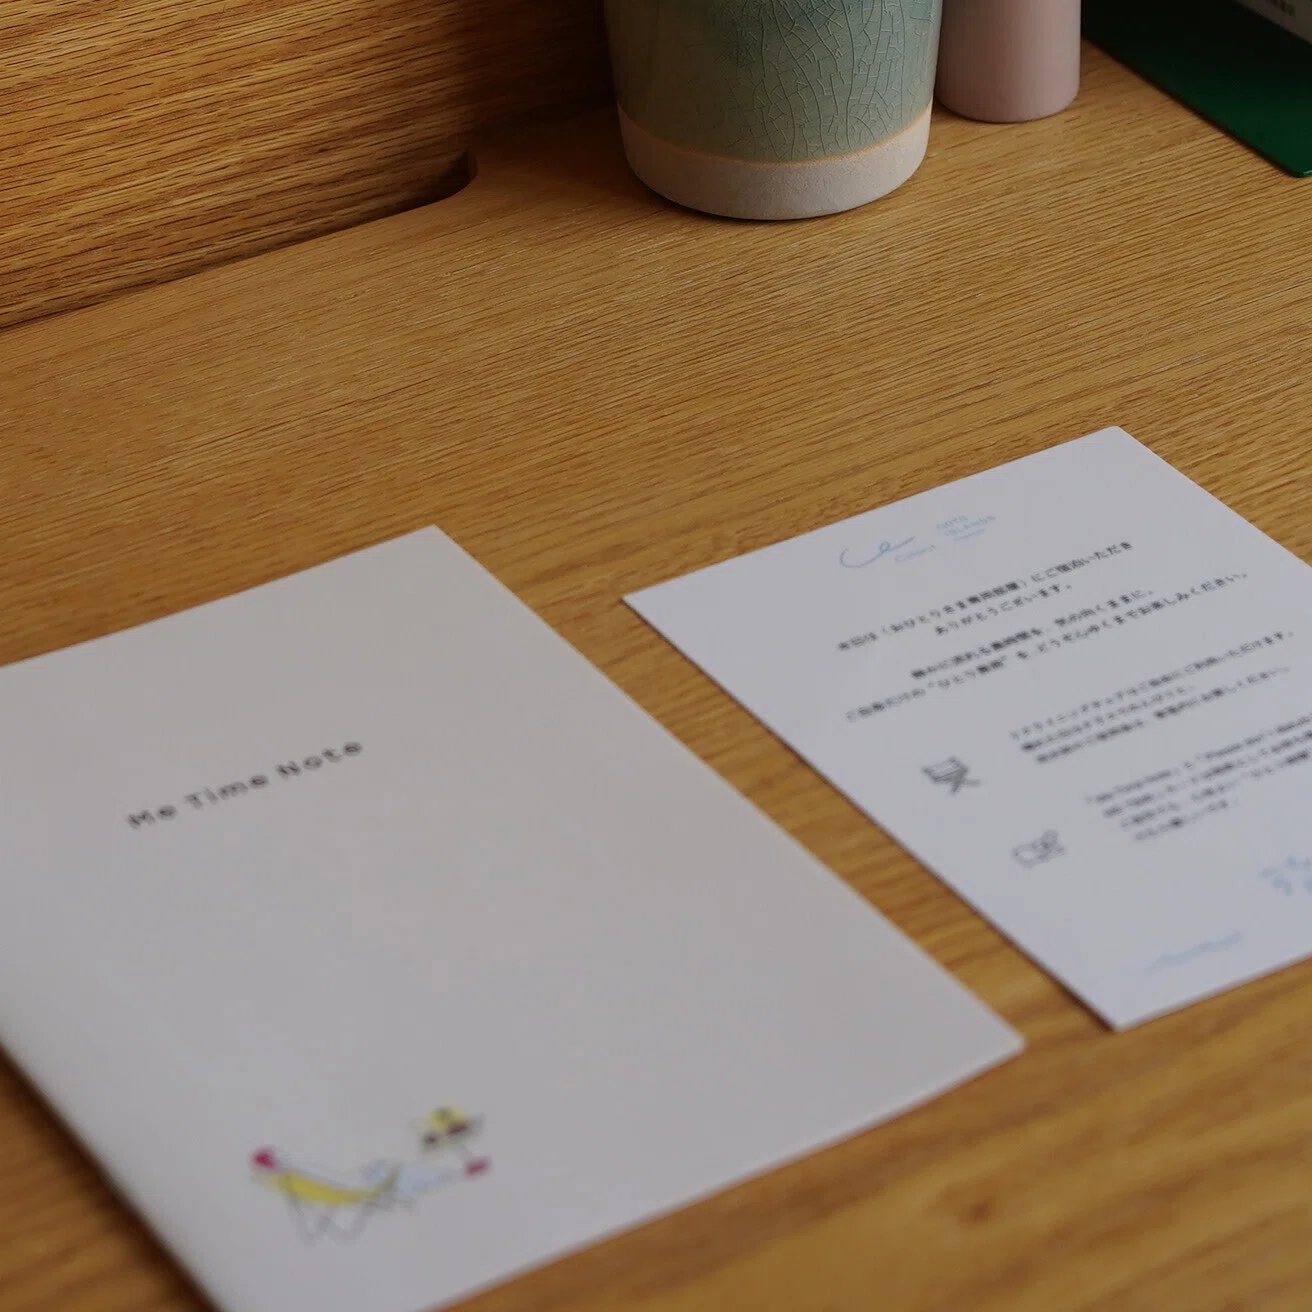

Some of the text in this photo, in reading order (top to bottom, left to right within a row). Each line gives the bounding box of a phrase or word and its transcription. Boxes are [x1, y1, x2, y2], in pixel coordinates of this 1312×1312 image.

[126, 741, 364, 830] Me Time Note
